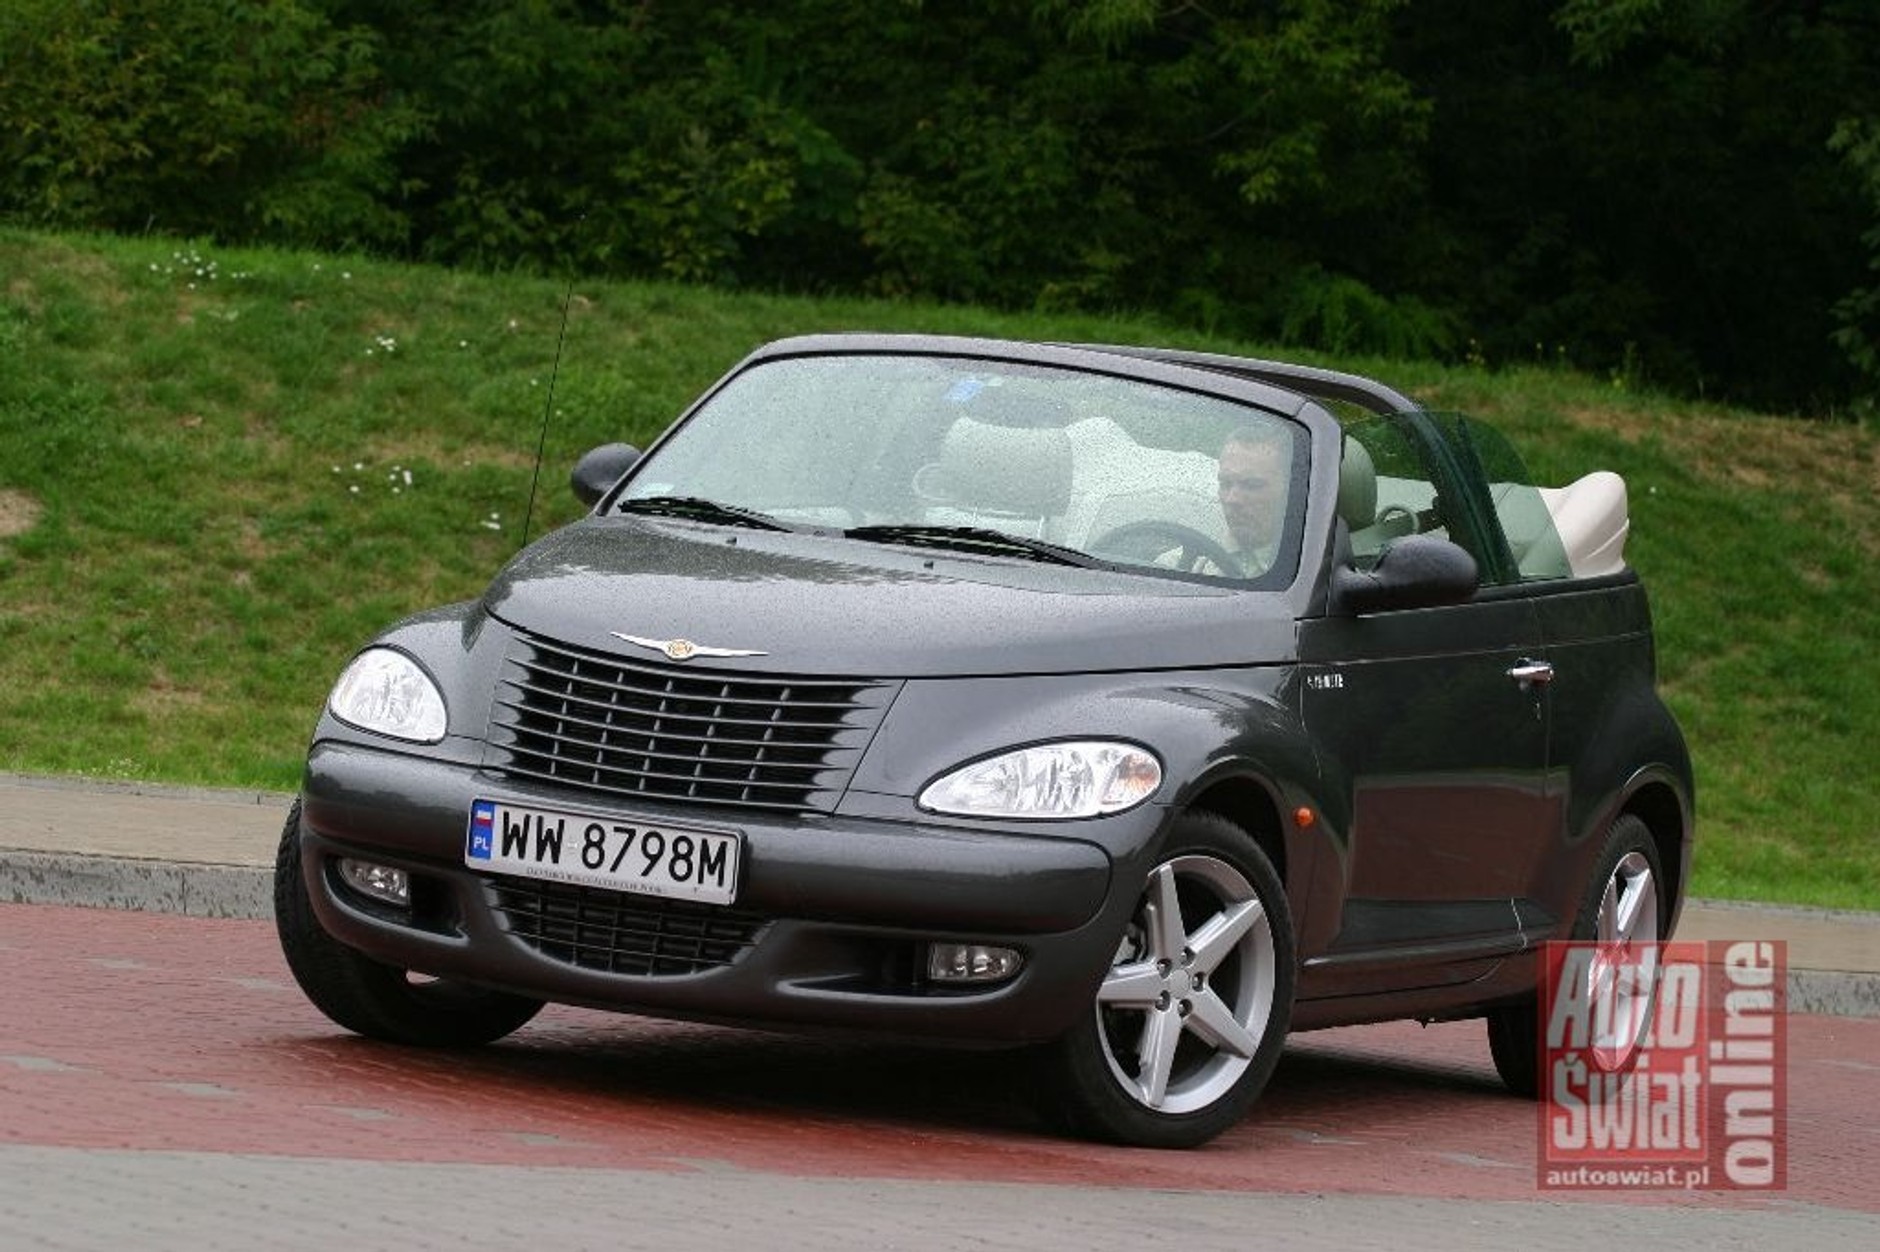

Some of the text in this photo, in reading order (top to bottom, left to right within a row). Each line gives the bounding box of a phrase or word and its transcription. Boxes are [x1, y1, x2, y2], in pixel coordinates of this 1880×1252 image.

[473, 836, 490, 851] PL
[501, 811, 565, 864] WW
[581, 823, 728, 887] 8798M
